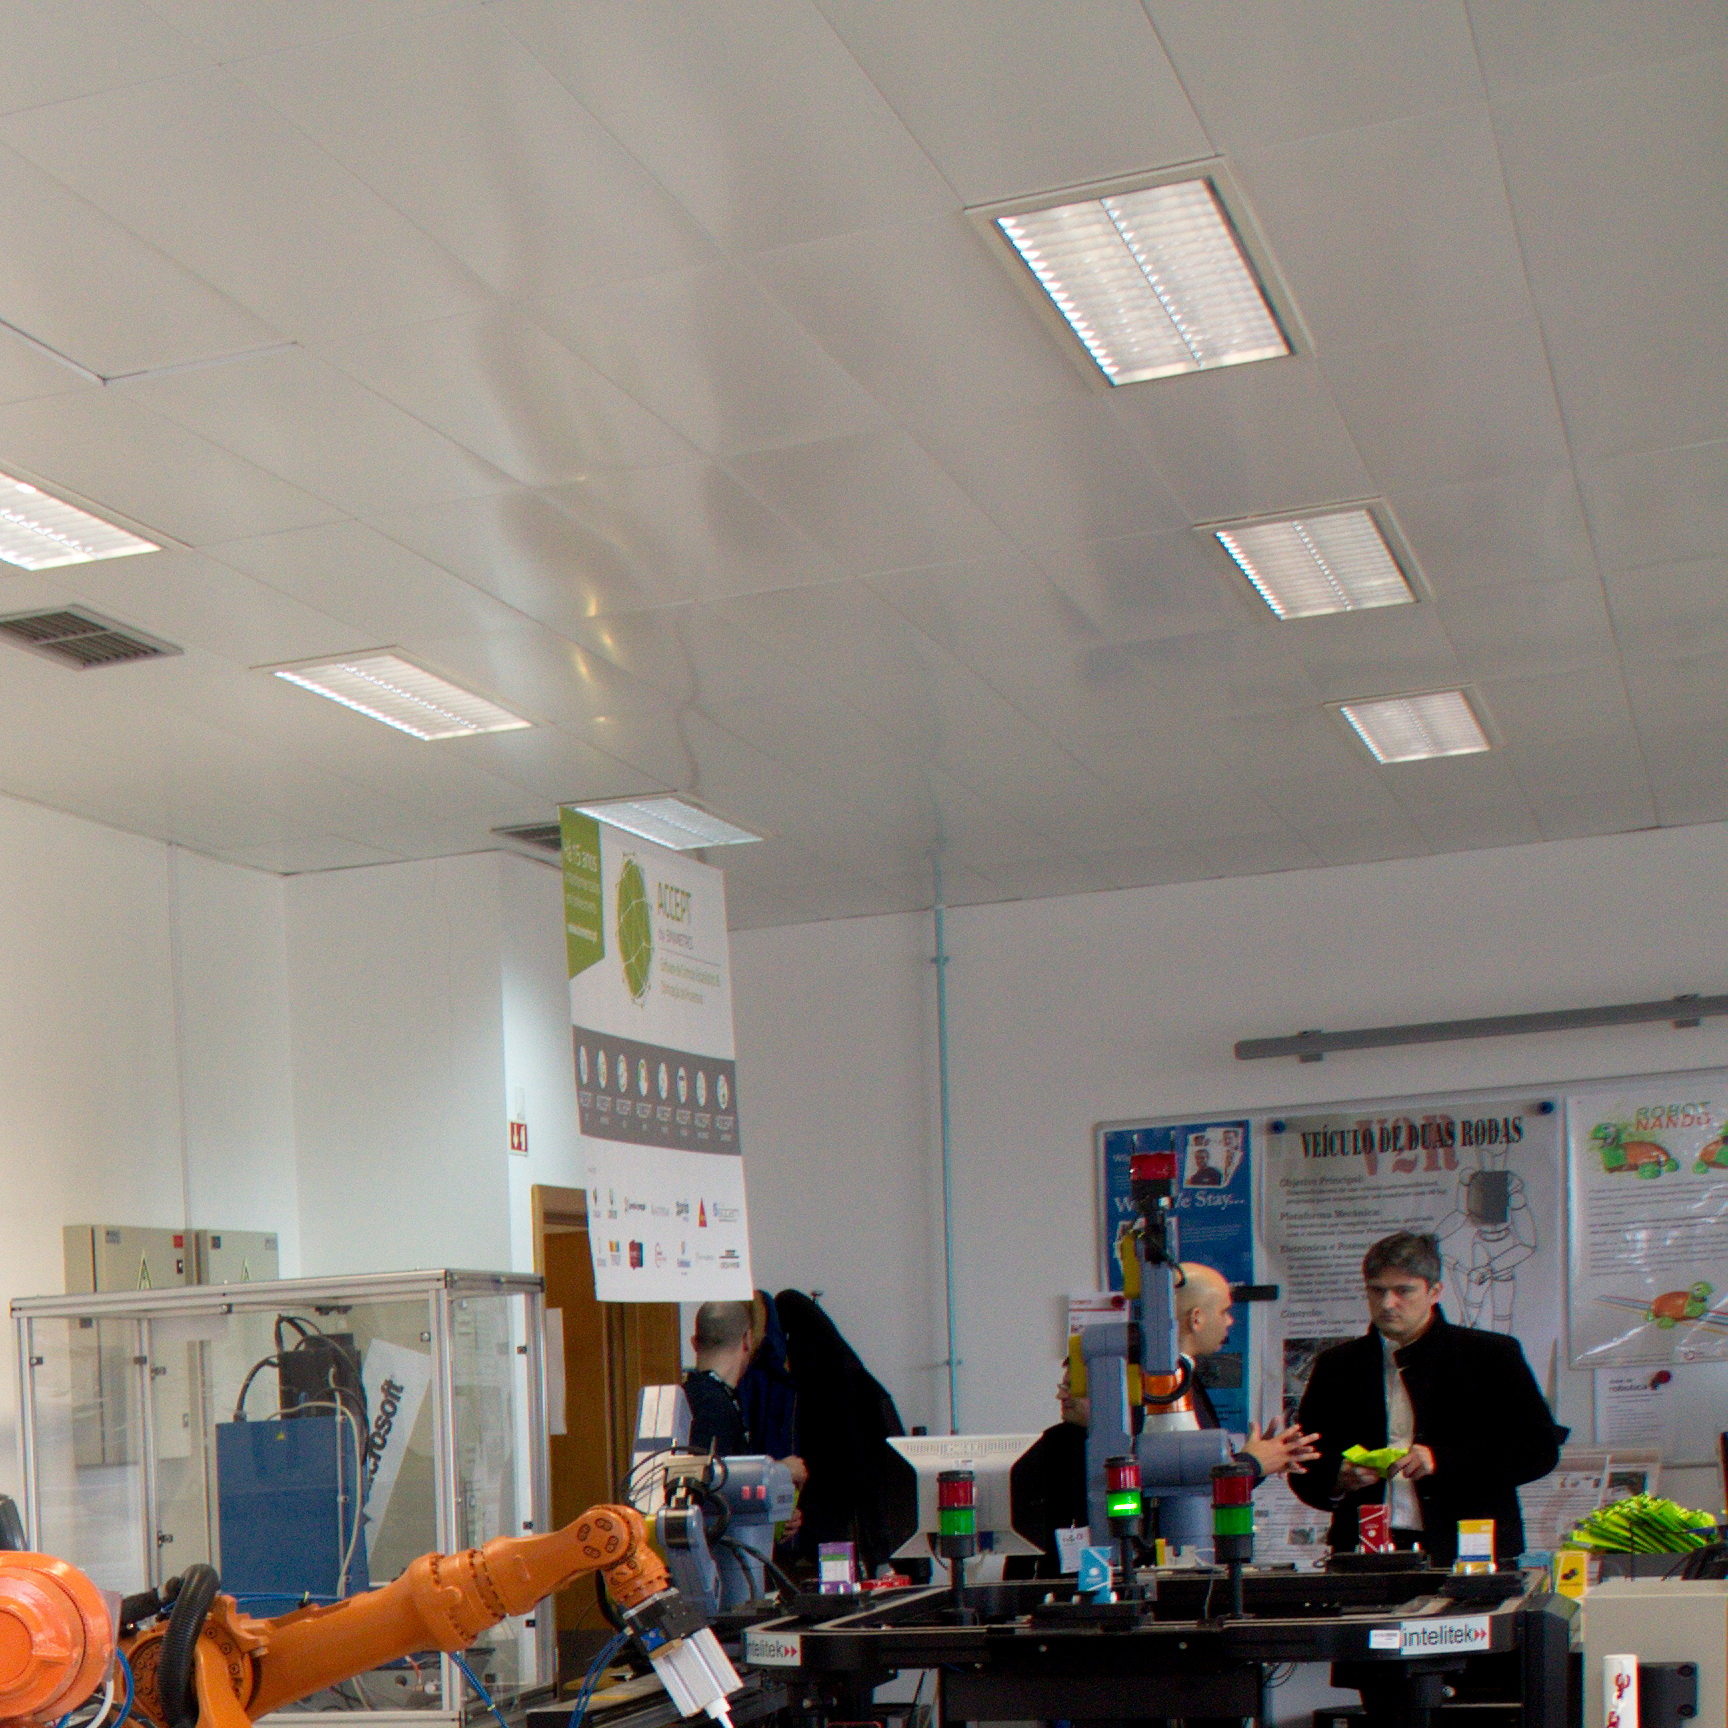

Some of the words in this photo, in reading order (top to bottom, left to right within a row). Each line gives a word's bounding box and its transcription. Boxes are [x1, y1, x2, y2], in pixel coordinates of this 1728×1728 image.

[1636, 1101, 1712, 1120] ROBOT
[1636, 1112, 1711, 1132] NANDO
[1300, 1124, 1376, 1159] VEÍCULO
[1410, 1120, 1456, 1150] DUAS
[1460, 1115, 1524, 1147] RODAS
[1402, 1624, 1476, 1649] intelitek
